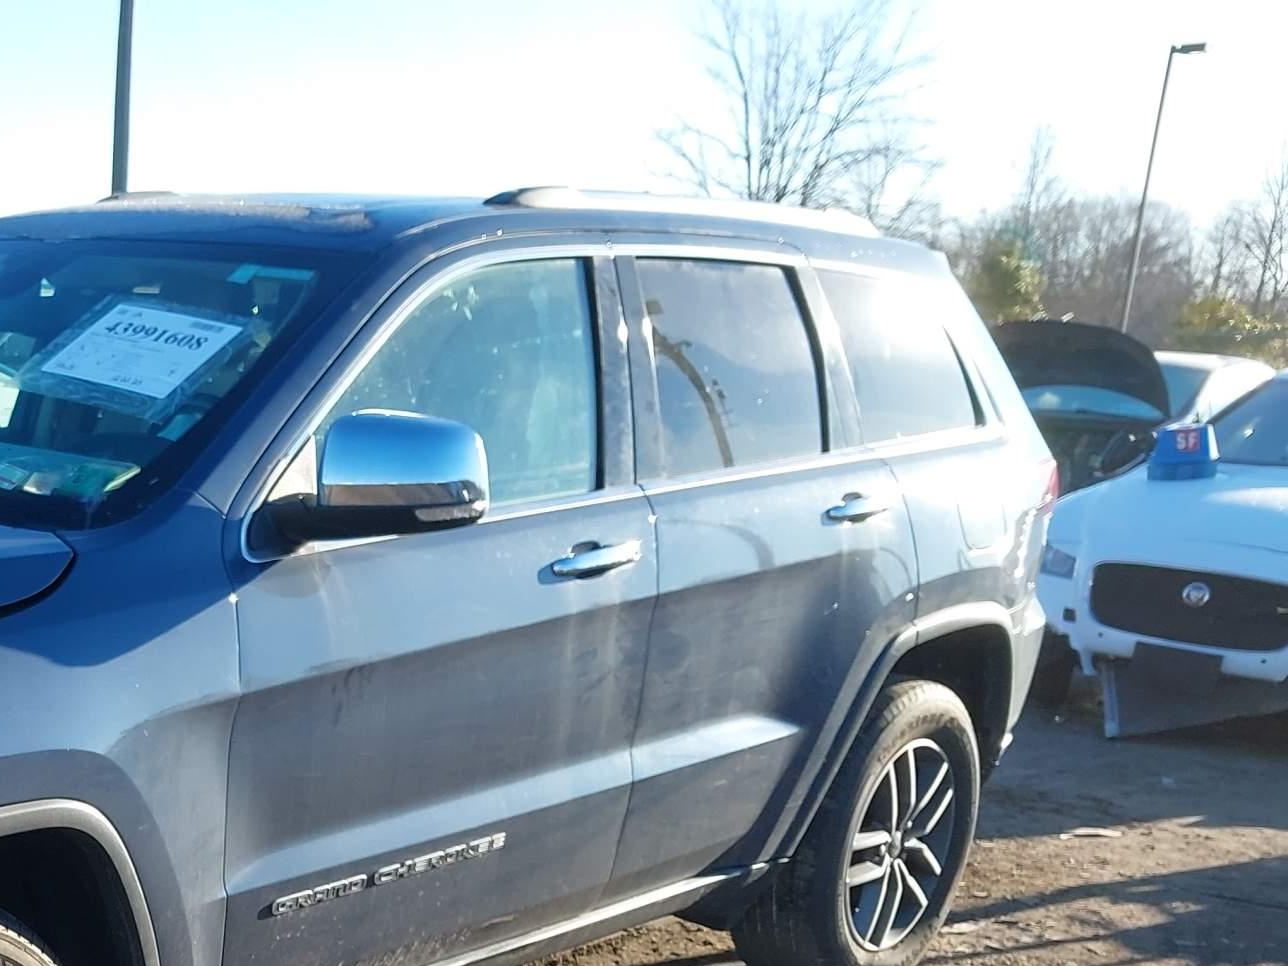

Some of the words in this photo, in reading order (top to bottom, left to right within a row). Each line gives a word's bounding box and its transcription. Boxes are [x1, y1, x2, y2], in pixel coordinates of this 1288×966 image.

[105, 320, 209, 350] 43991608
[271, 873, 368, 916] GRAND
[374, 831, 507, 886] CHEROKEE
